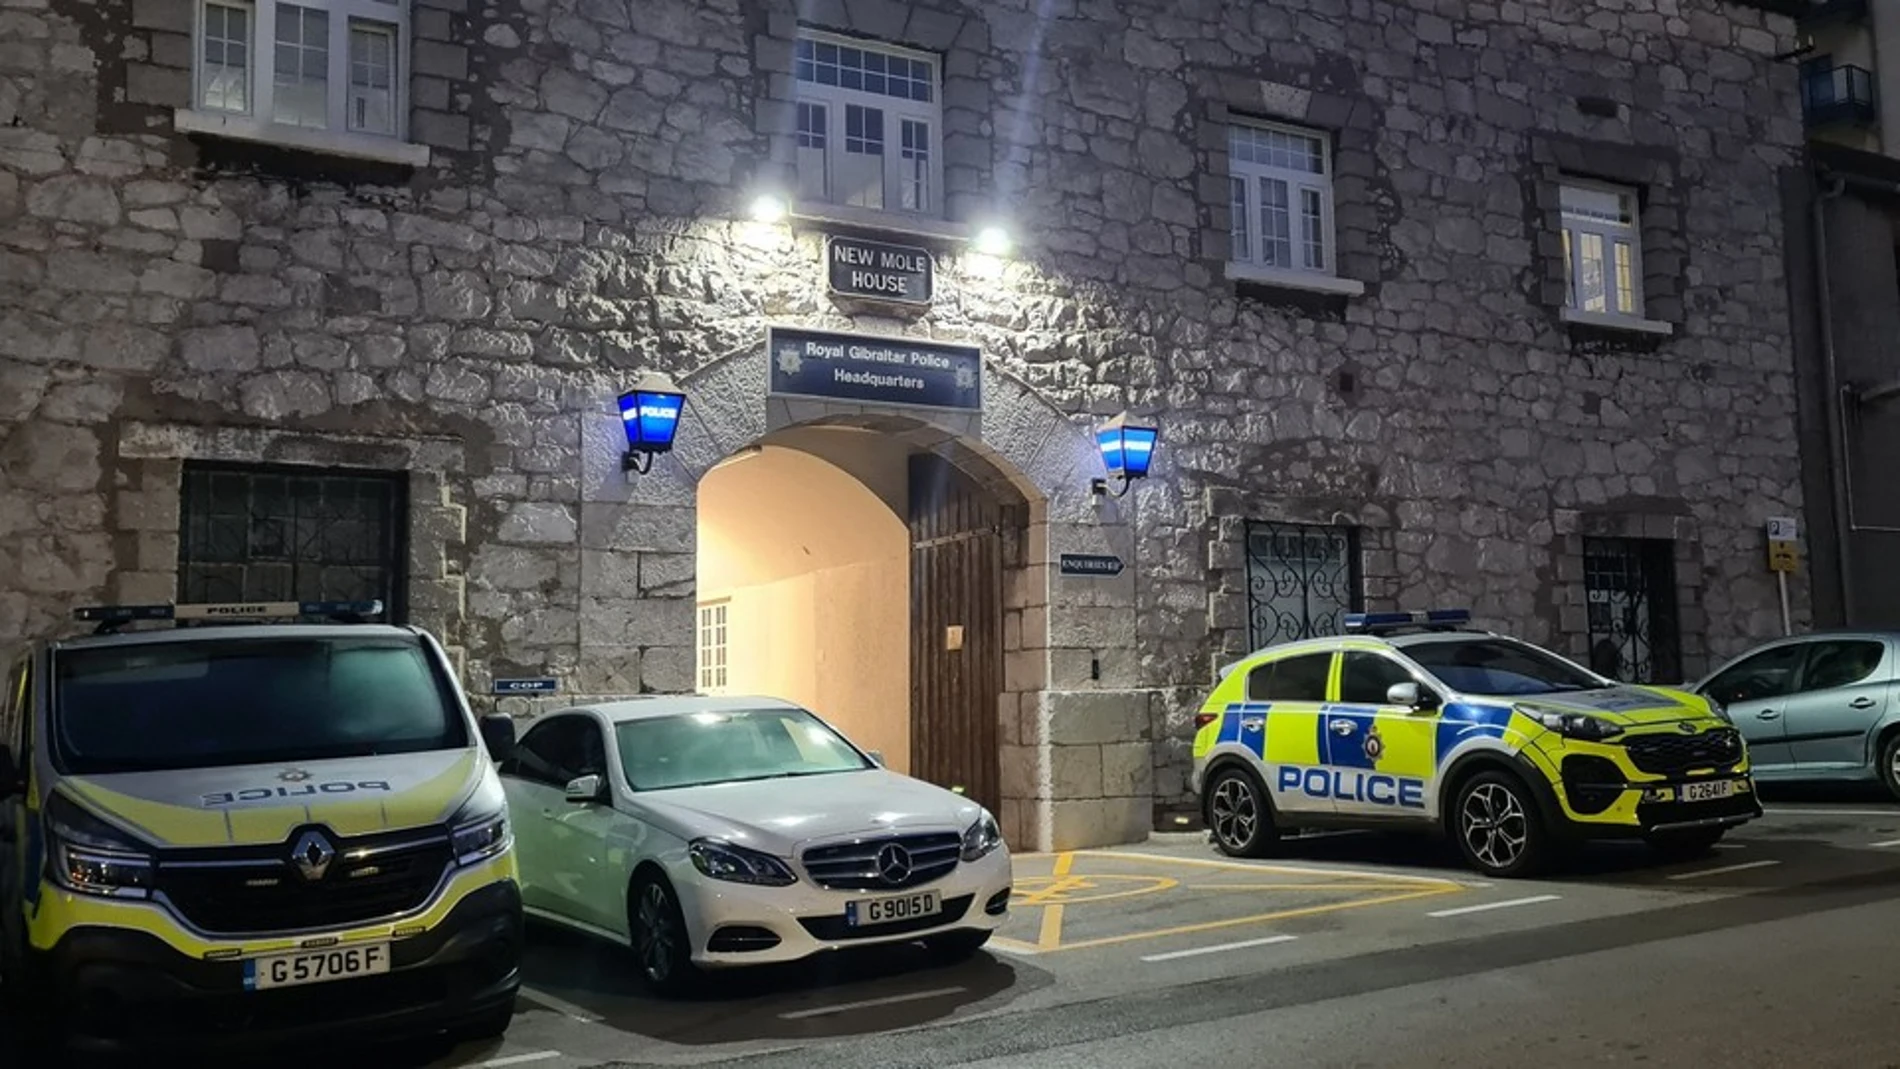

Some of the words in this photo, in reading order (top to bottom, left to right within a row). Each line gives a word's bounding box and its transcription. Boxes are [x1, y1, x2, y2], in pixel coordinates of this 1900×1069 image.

[834, 244, 874, 266] NEW
[881, 251, 925, 273] MOLE
[852, 270, 908, 294] HOUSE
[805, 341, 844, 359] Royal
[849, 345, 906, 363] Gibraltar
[911, 351, 950, 368] Police
[834, 368, 925, 388] Headquarters
[640, 405, 677, 419] POLICE
[206, 606, 266, 614] POLICE
[1278, 766, 1425, 809] POLICE
[870, 902, 880, 920] G
[884, 896, 921, 918] 9015
[272, 960, 287, 982] G
[293, 950, 360, 979] 5706
[366, 947, 380, 970] F
